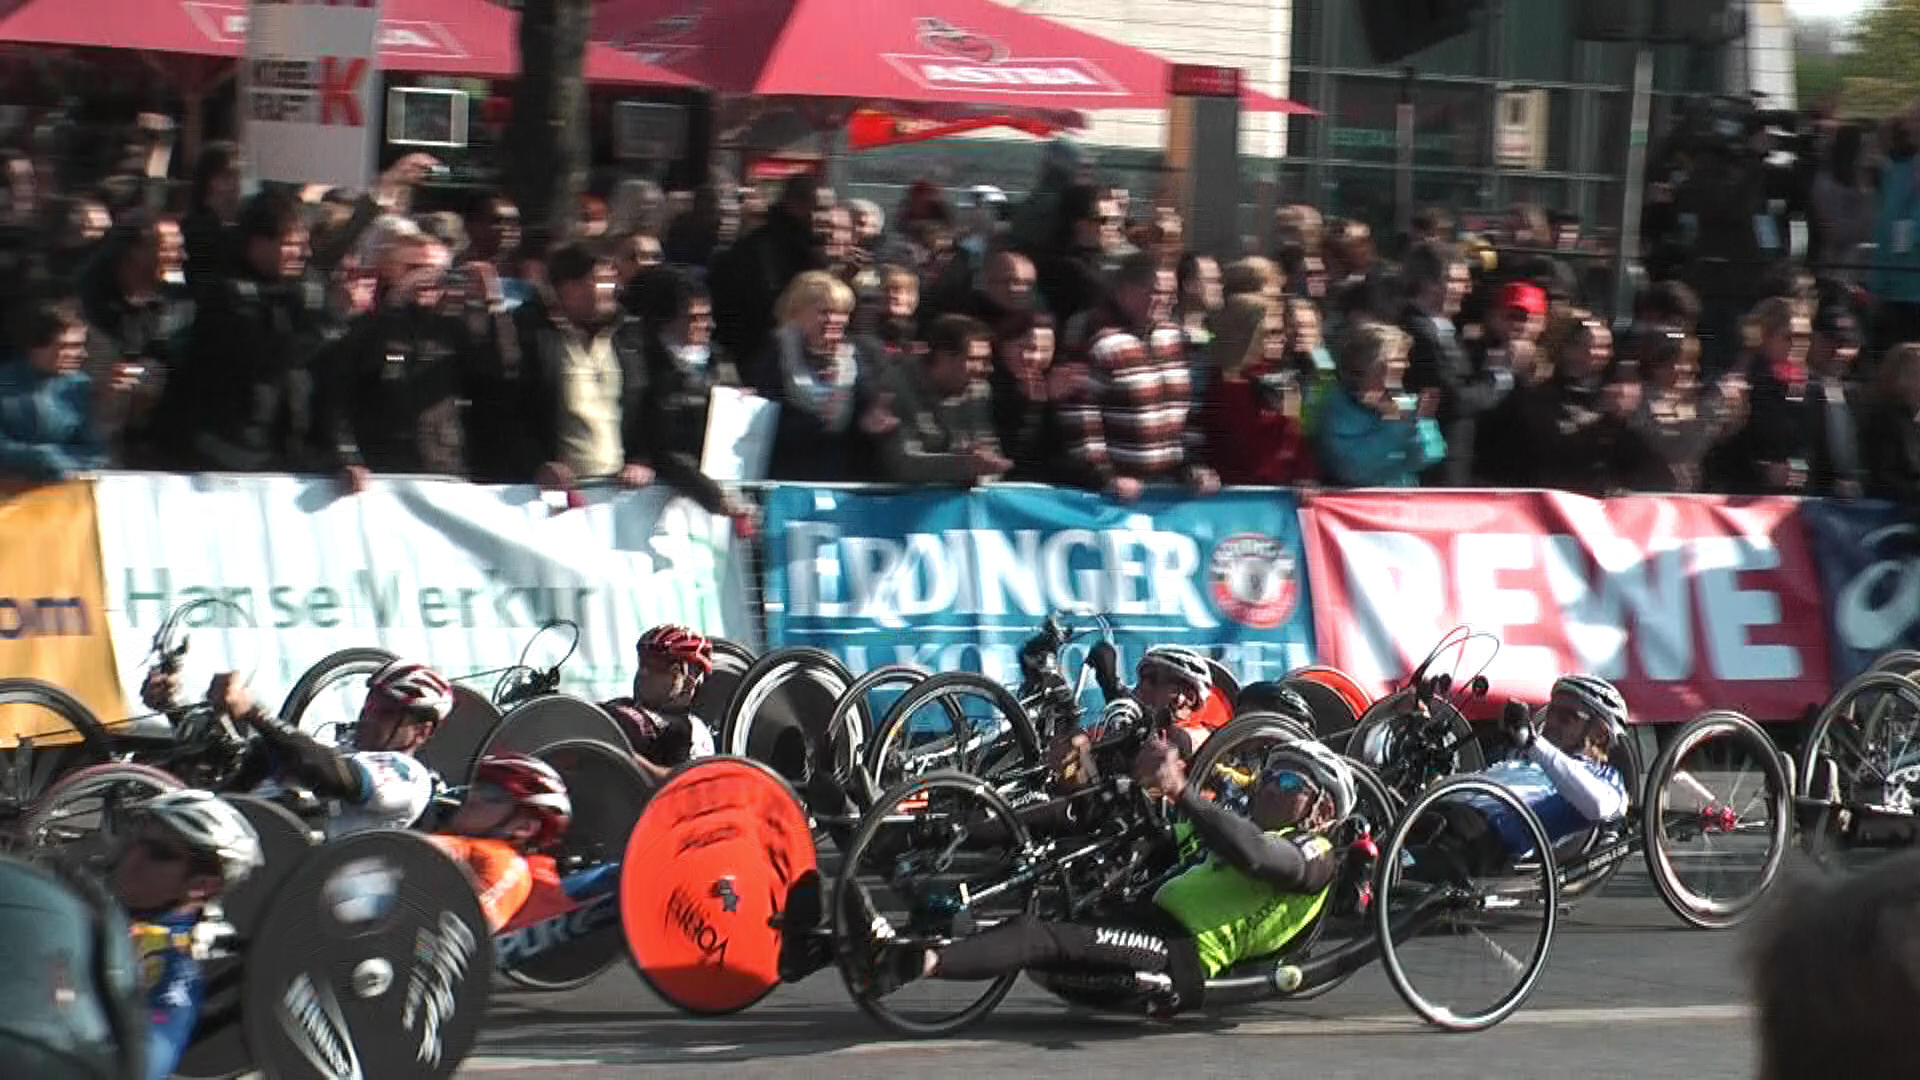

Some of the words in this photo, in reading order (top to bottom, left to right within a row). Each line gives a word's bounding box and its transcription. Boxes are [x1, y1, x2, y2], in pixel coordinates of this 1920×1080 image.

[921, 64, 1099, 85] ASTRA
[785, 521, 1220, 627] ERDINGER
[1337, 529, 1803, 681] REWE
